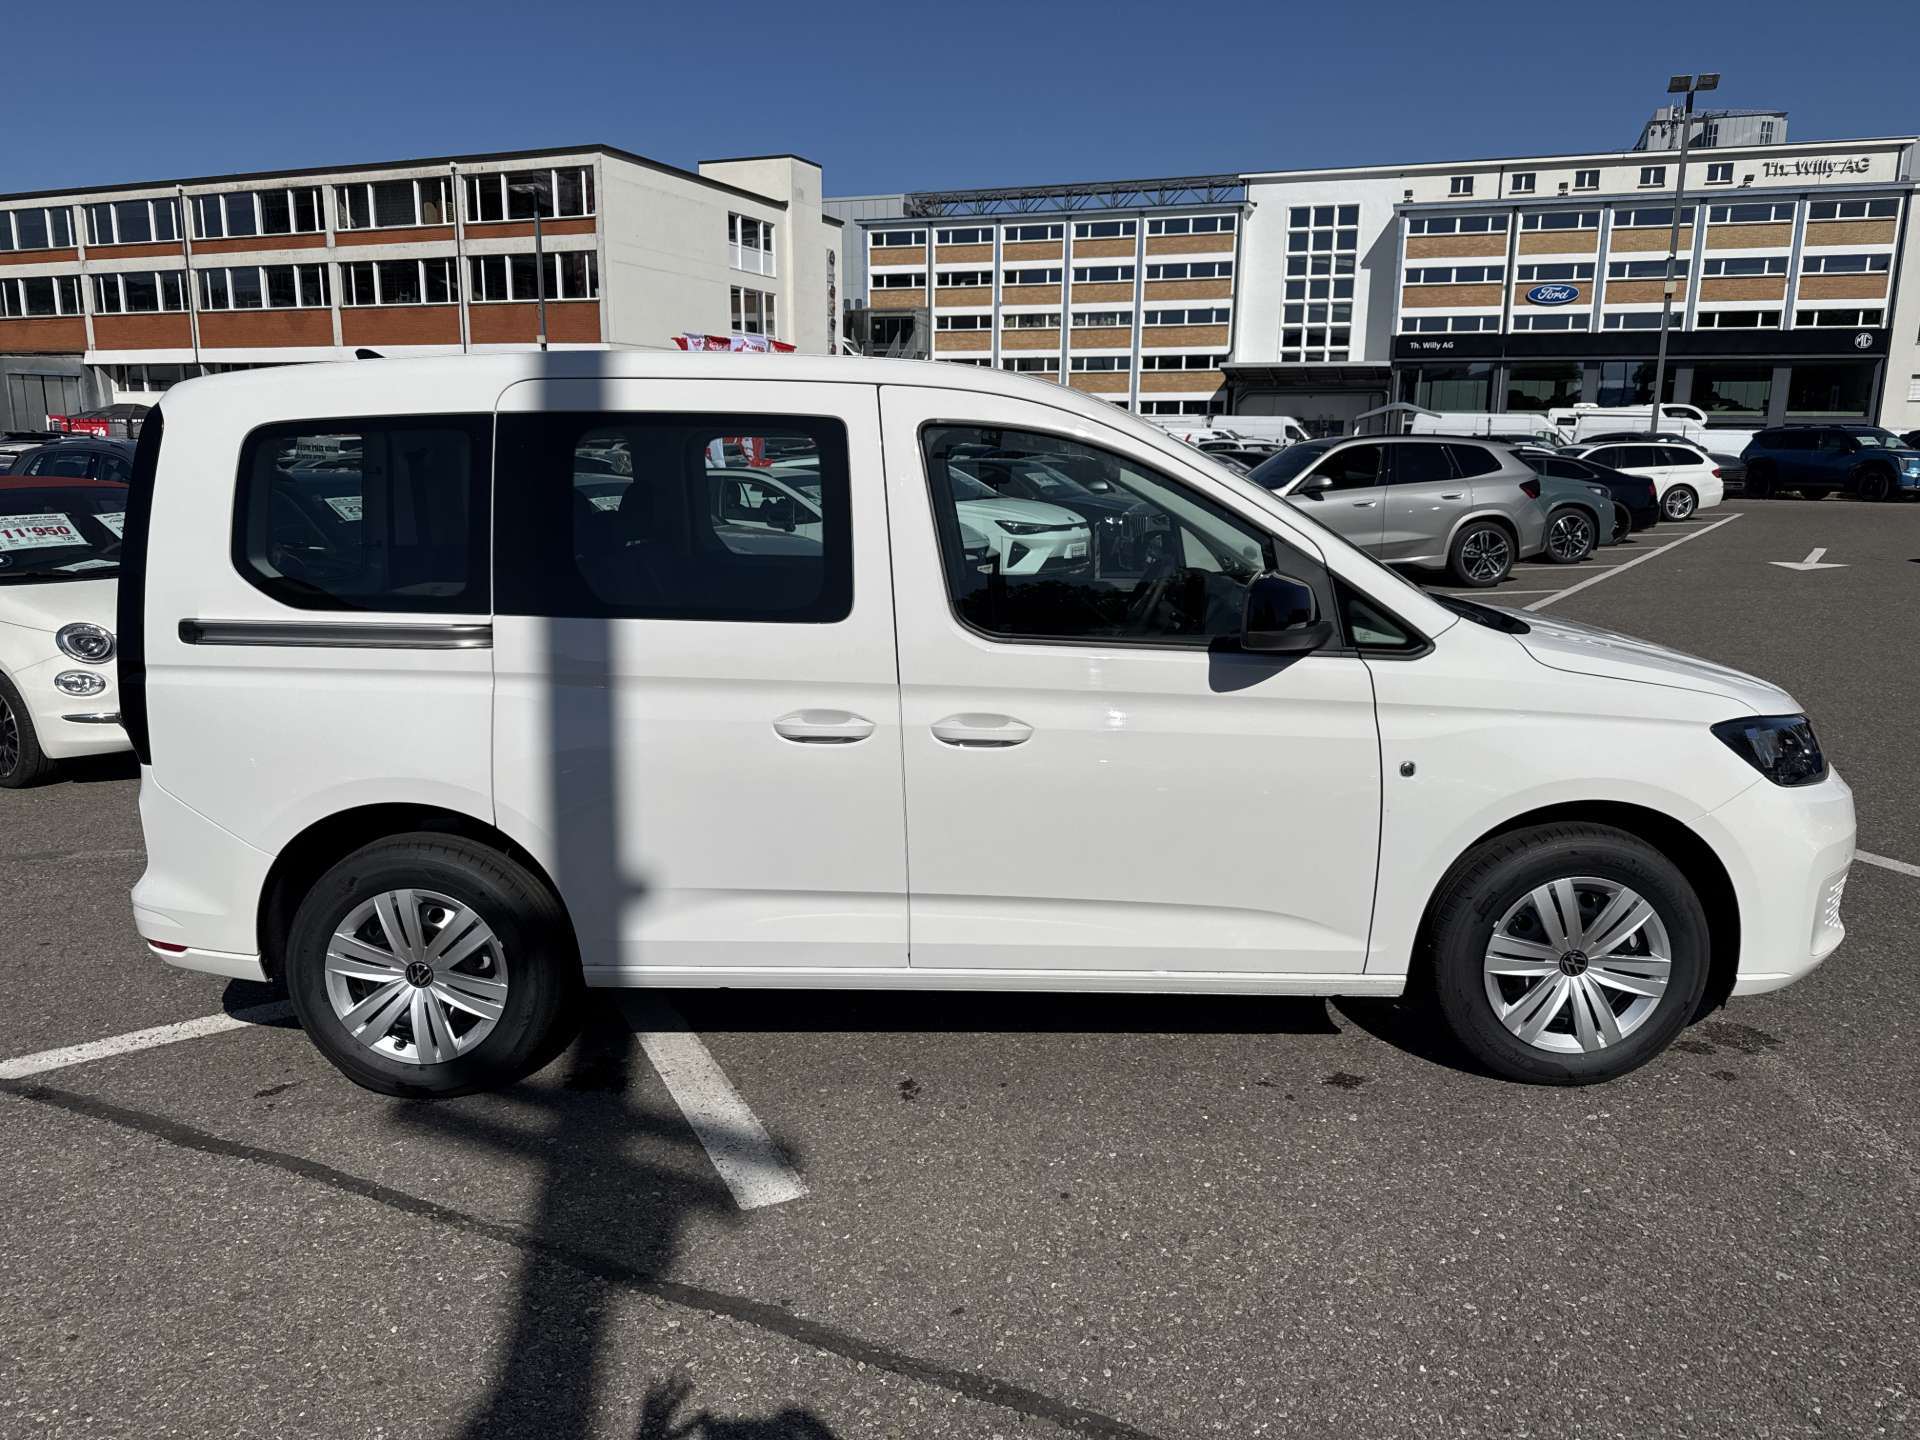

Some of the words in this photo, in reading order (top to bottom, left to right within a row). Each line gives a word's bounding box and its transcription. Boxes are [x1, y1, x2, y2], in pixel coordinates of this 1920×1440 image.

[1762, 161, 1788, 177] Th.
[1795, 159, 1836, 178] Willy
[1840, 157, 1871, 174] AG
[1537, 286, 1569, 300] Ford
[1423, 341, 1441, 351] Willy
[1443, 341, 1454, 349] AG
[1856, 334, 1872, 348] MG
[0, 525, 71, 539] 11'950
